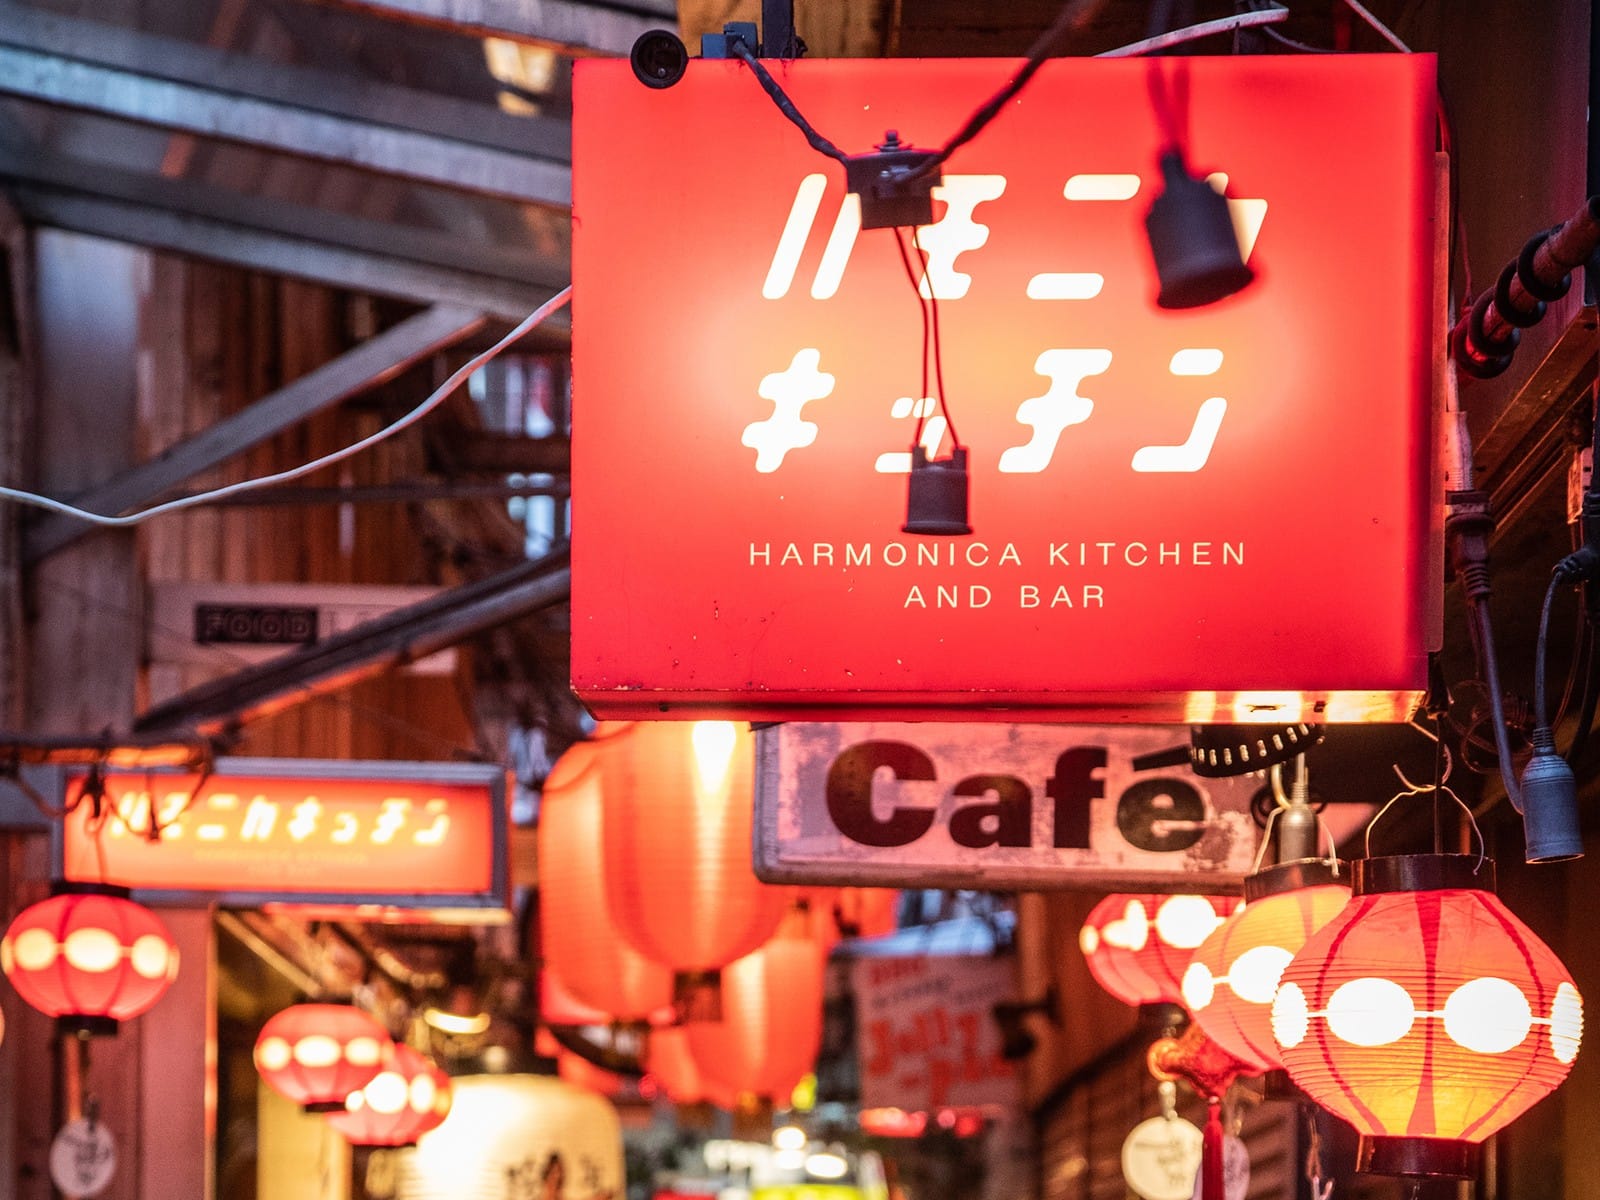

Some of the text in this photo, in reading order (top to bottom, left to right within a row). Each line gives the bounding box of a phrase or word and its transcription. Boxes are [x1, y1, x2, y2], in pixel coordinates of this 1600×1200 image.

[761, 173, 1268, 300] ハモニ
[749, 542, 1245, 566] HARMONICA KITCHEN
[904, 585, 1105, 609] AND BAR
